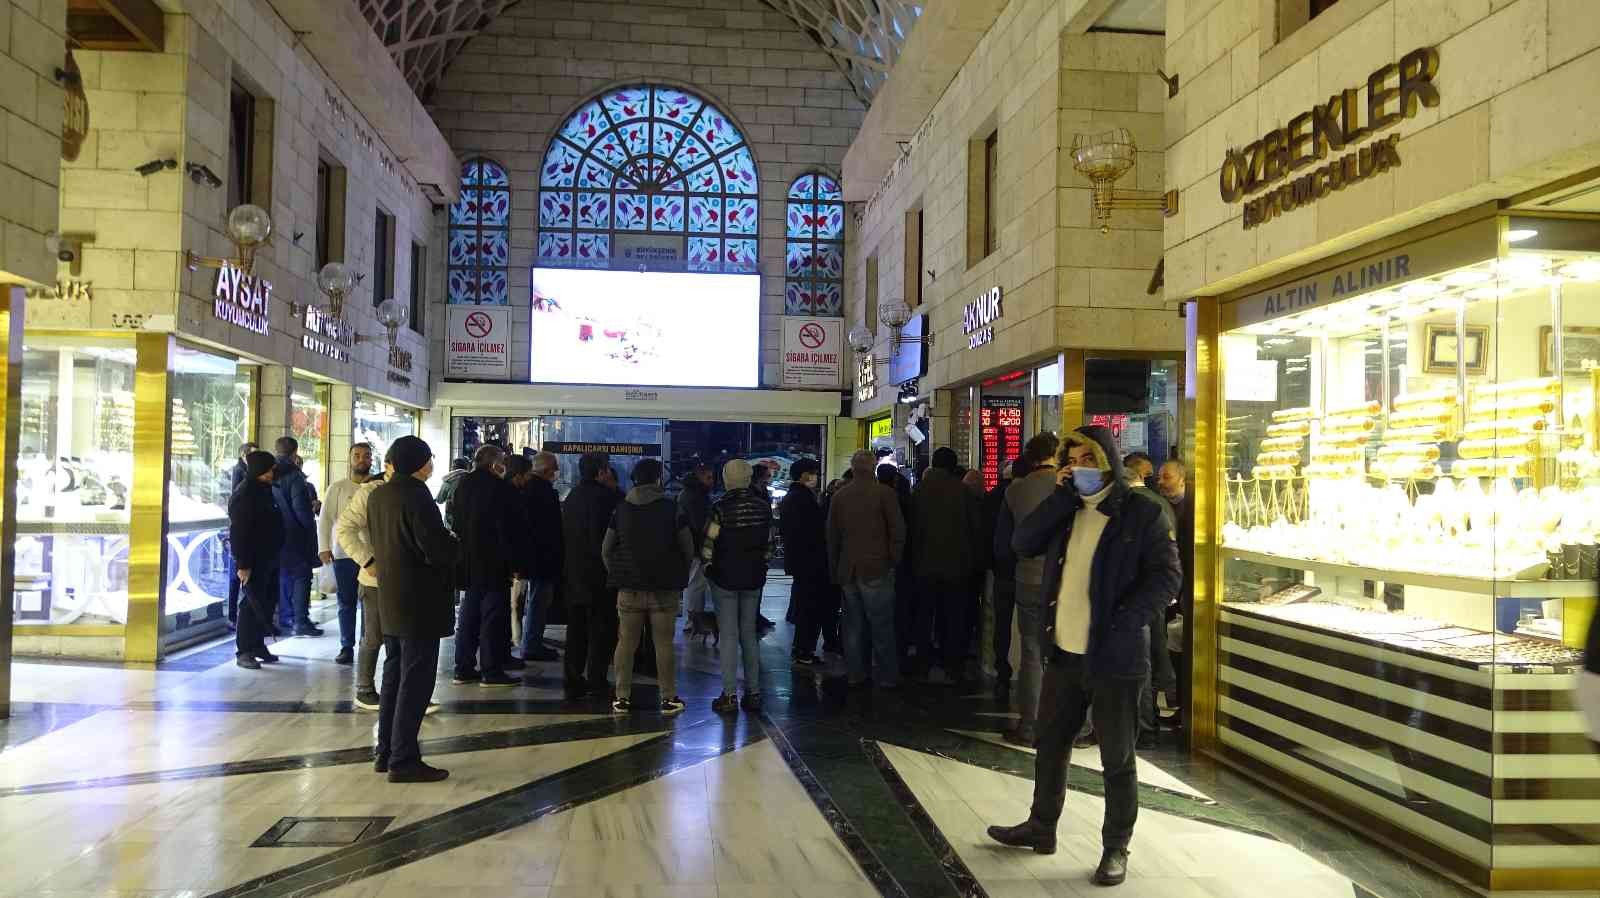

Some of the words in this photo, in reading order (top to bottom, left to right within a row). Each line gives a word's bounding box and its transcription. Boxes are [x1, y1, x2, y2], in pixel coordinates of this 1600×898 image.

[1220, 47, 1440, 203] ÖZBEKLER
[216, 260, 272, 316] AYSAT
[963, 286, 1001, 335] AKNUR
[1264, 282, 1318, 316] ALTIN
[1332, 254, 1410, 298] ALINIR
[215, 299, 269, 336] KUYUMCULUK
